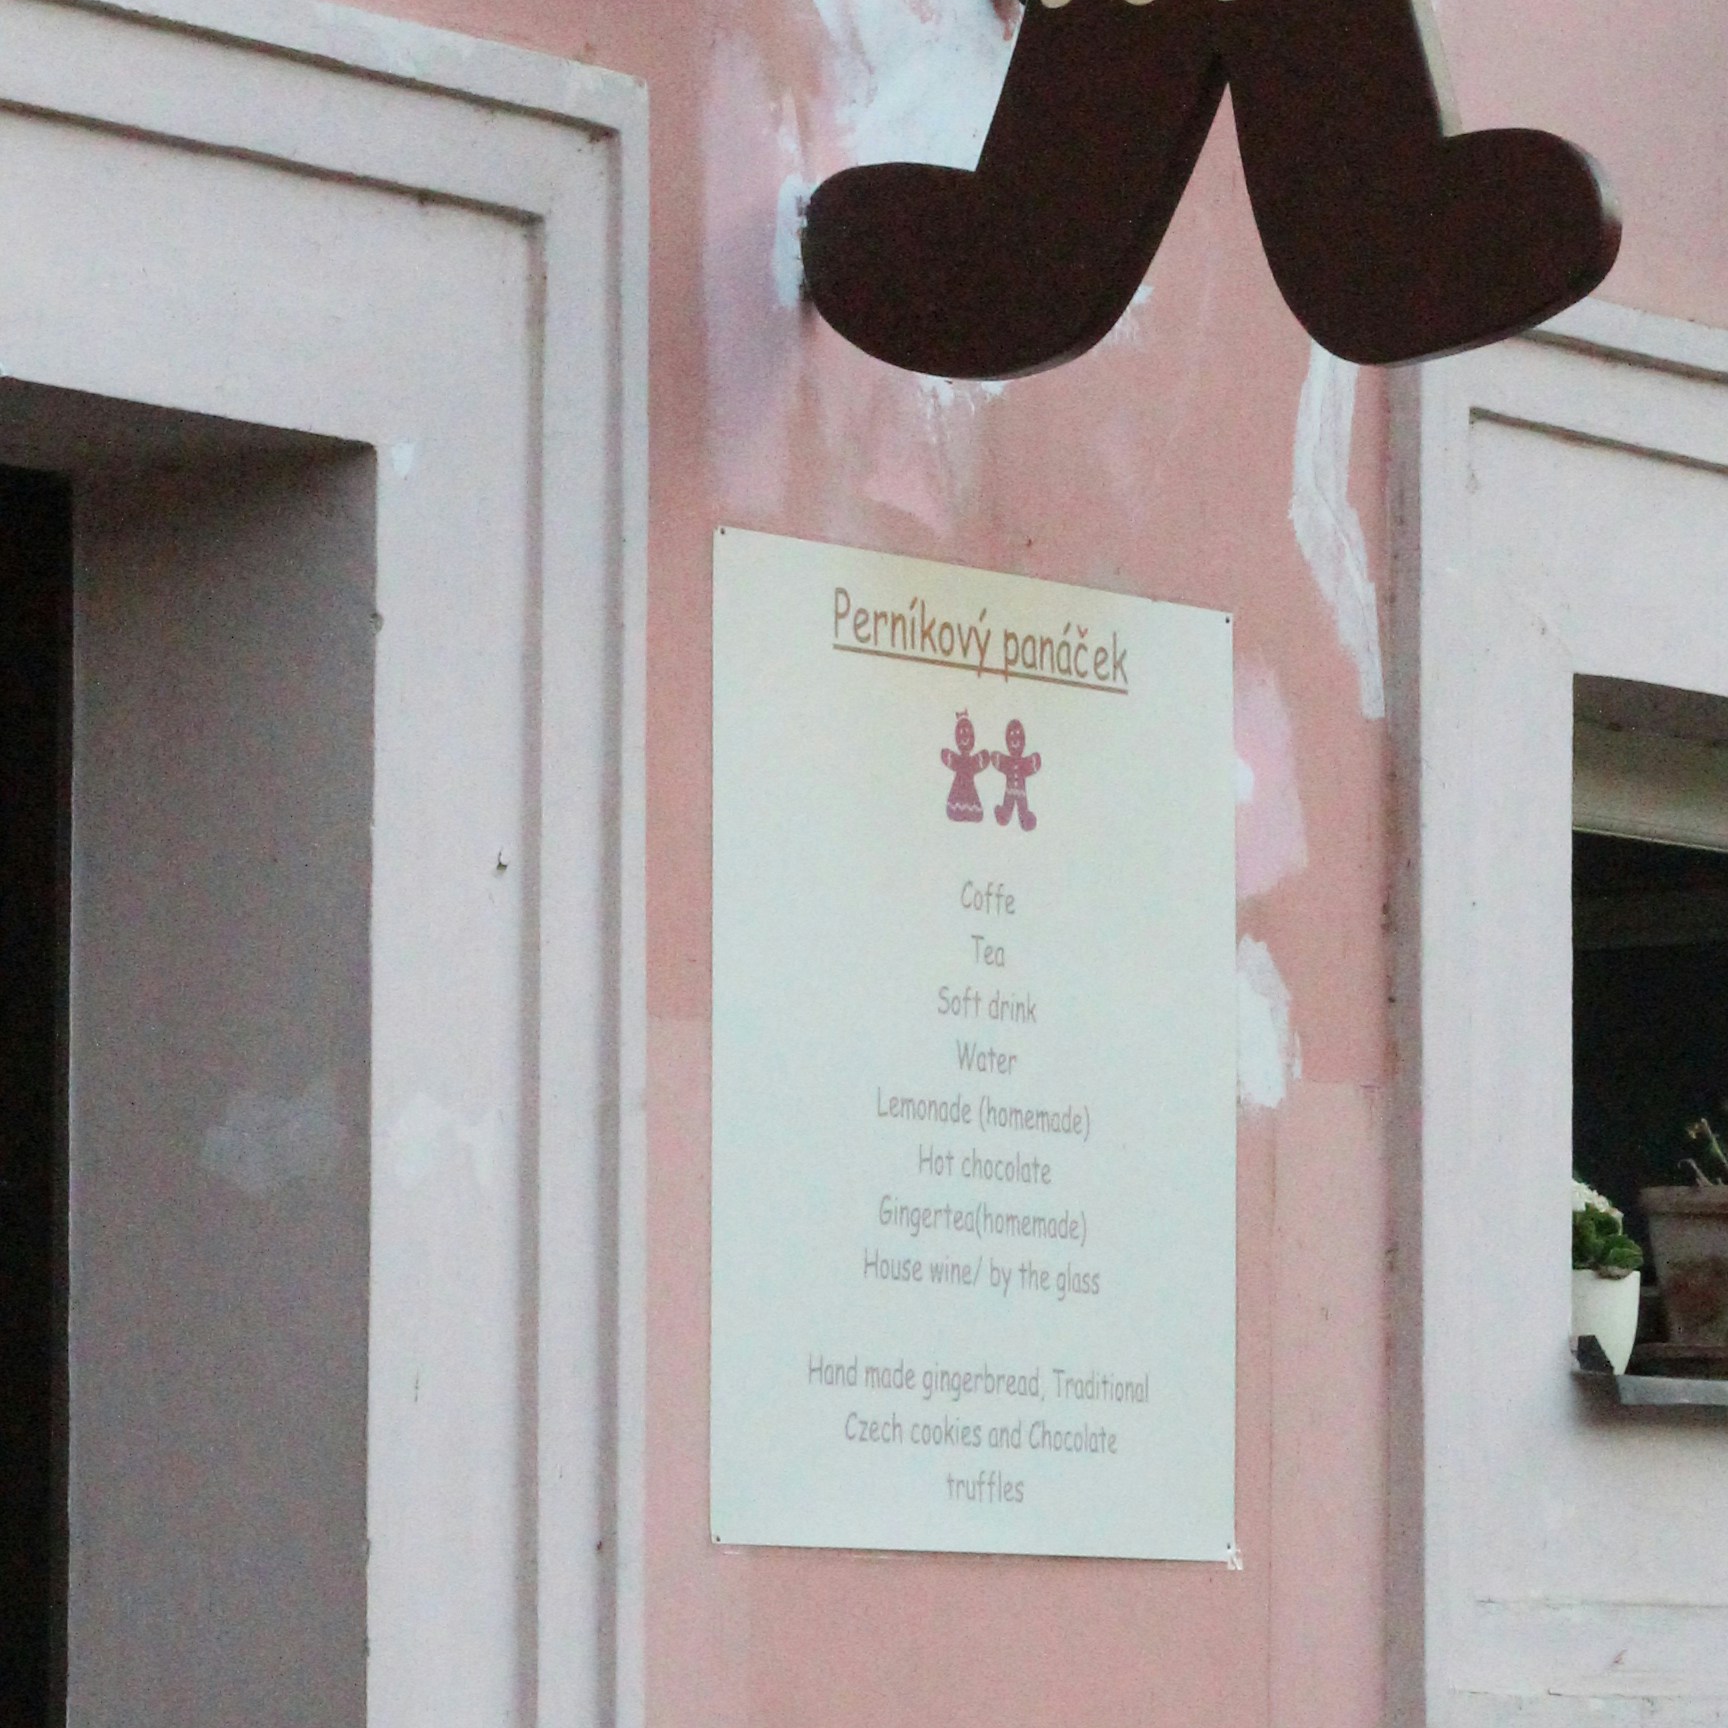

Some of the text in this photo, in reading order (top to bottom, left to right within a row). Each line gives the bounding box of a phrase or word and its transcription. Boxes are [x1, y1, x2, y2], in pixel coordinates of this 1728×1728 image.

[834, 587, 1128, 683] Perníkový panáček
[961, 881, 1016, 915] Coffe
[971, 935, 1005, 967] Tea
[938, 986, 1037, 1023] Soft drink
[956, 1040, 1017, 1074] Water
[876, 1087, 1091, 1142] Lemonade (homemade)
[918, 1144, 1052, 1185] Hot chocolate
[863, 1248, 1100, 1301] House wine/ by the glass
[808, 1353, 1149, 1403] Hand made gingerbread, Traditional
[844, 1411, 1118, 1455] Czech cookies and Chocolate
[946, 1471, 1024, 1503] truffles
